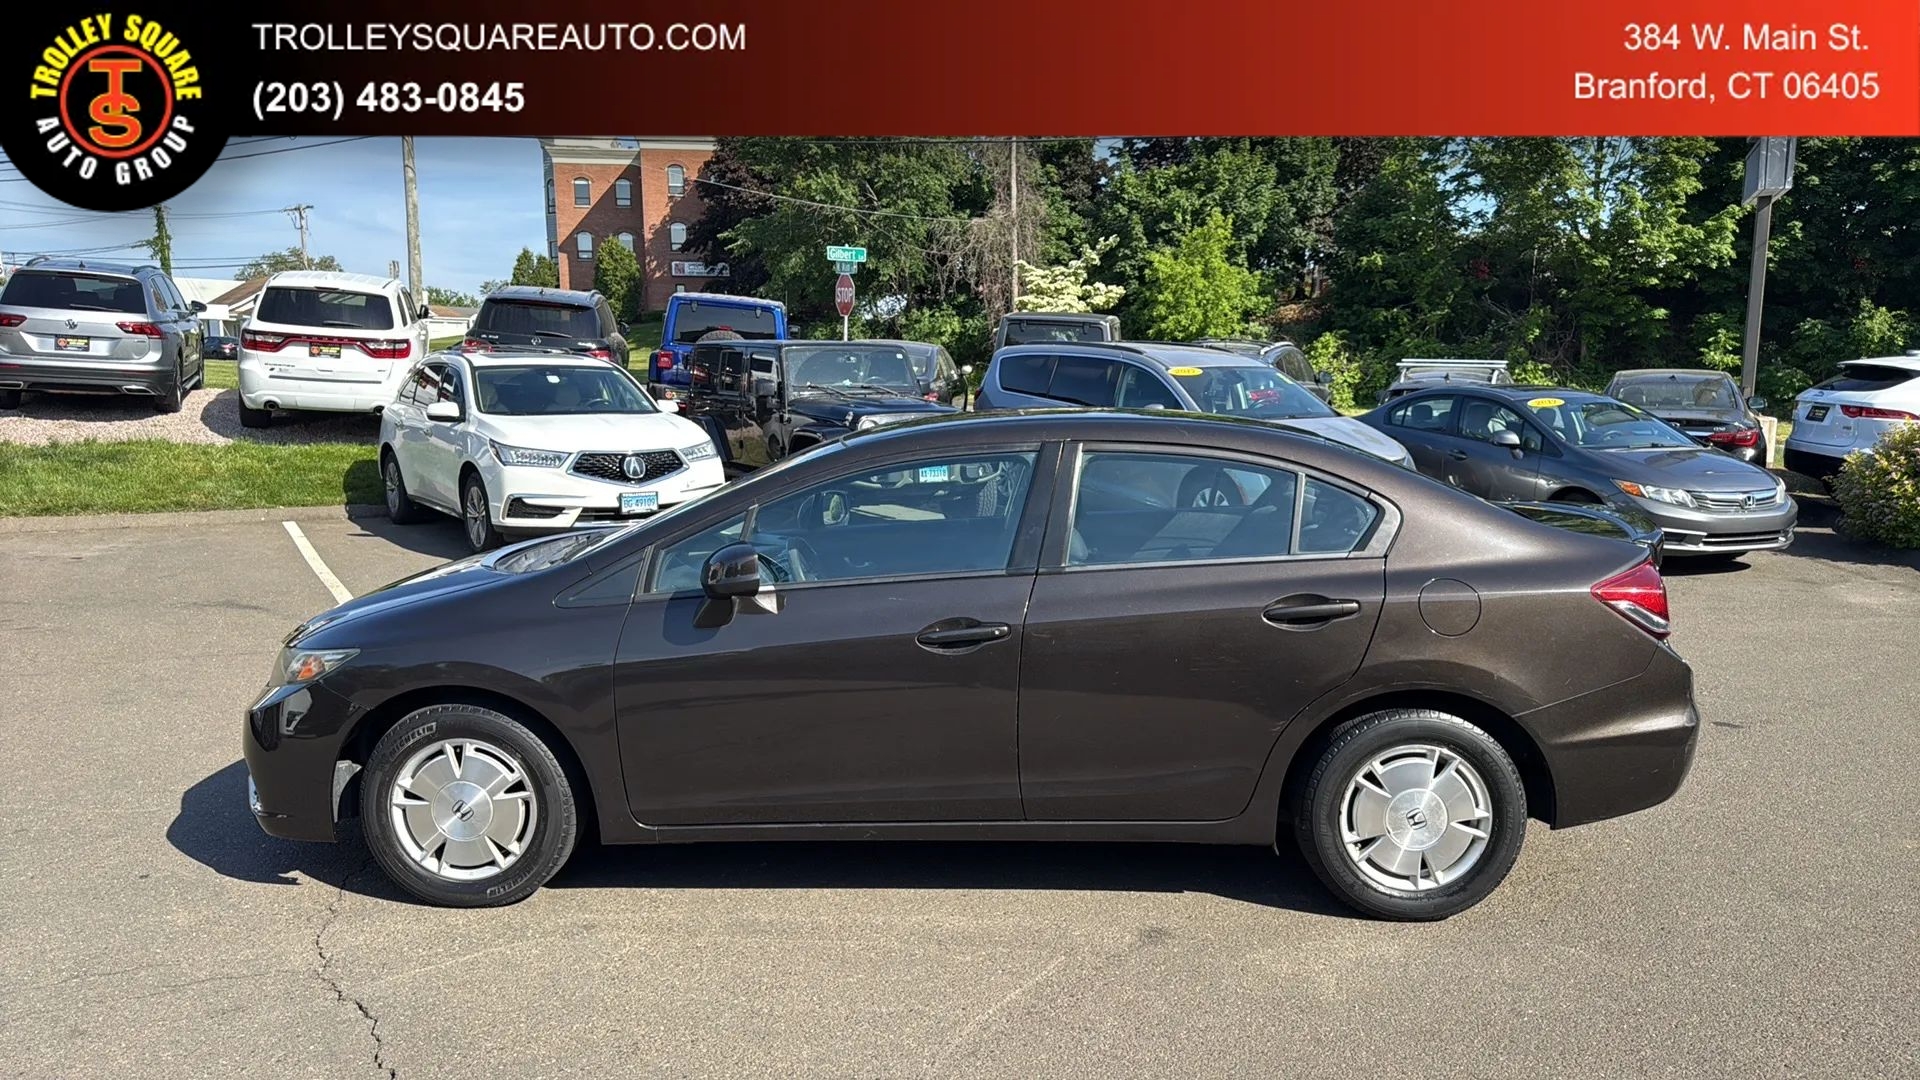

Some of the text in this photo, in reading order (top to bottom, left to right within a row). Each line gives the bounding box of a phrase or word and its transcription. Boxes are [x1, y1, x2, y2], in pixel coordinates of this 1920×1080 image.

[830, 248, 856, 260] Gilbert
[837, 287, 853, 303] STOP
[389, 722, 437, 760] MICHELIN
